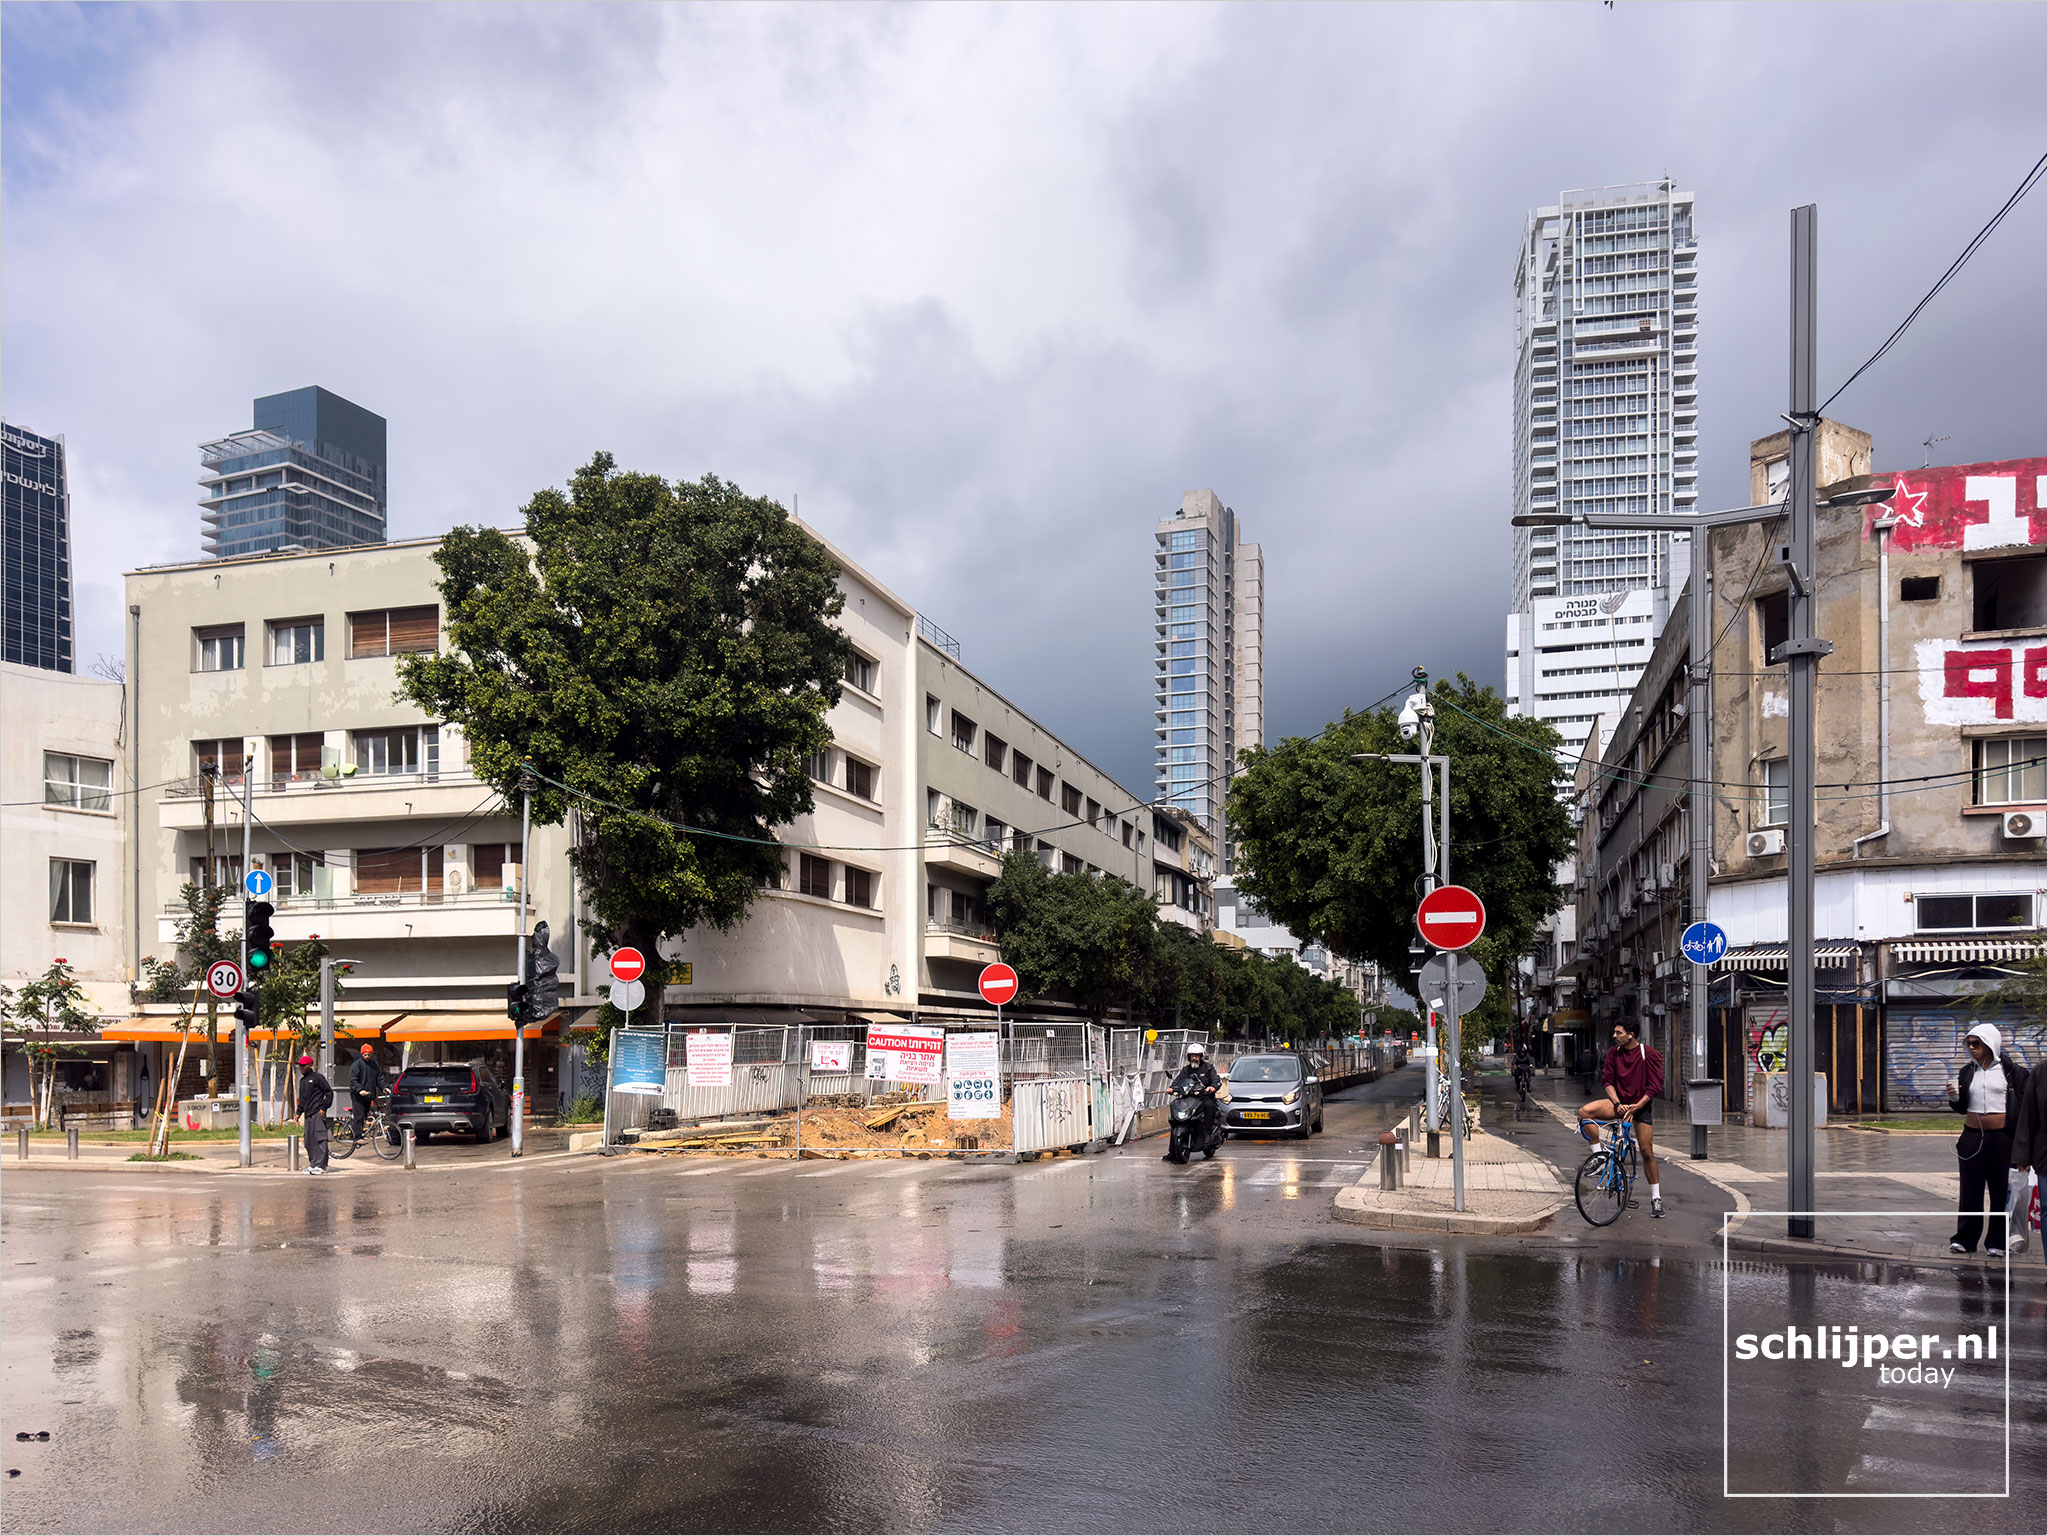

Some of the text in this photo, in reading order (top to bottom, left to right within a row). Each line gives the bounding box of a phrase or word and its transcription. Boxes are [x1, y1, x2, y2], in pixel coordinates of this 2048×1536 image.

[1566, 599, 1597, 609] מנורה
[1555, 608, 1597, 619] מבטחים
[214, 971, 236, 987] 30
[868, 1037, 908, 1048] CAUTION
[908, 1039, 942, 1050] זהירות!
[899, 1052, 936, 1061] אתר בניה
